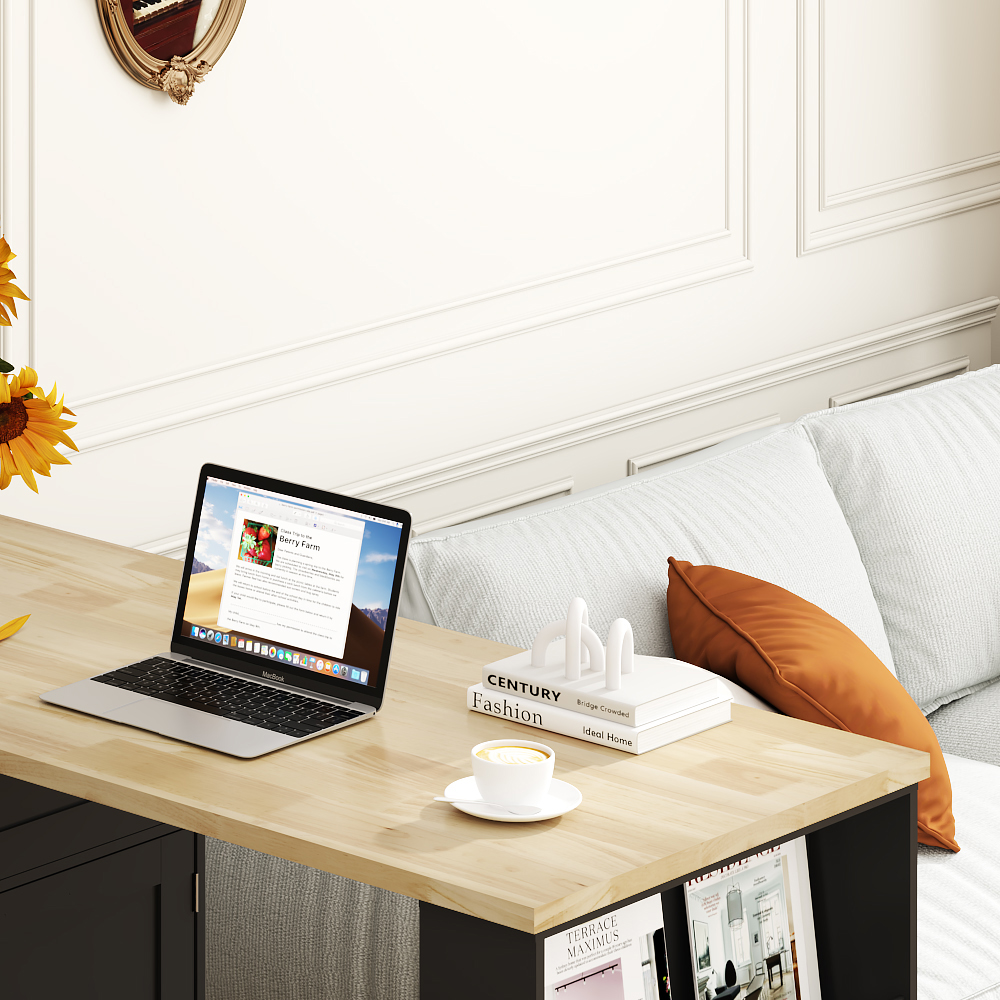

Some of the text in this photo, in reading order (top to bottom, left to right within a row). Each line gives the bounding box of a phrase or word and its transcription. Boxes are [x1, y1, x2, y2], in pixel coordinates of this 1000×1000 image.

[280, 535, 320, 551] Berry Farm
[262, 670, 284, 682] MacBook
[487, 674, 561, 701] CENTURY
[472, 691, 543, 725] Fashion
[577, 699, 630, 718] Bridge Crowded
[582, 726, 633, 746] Ideal Home
[566, 914, 618, 944] TERRACE
[567, 930, 619, 960] MAXIMUS
